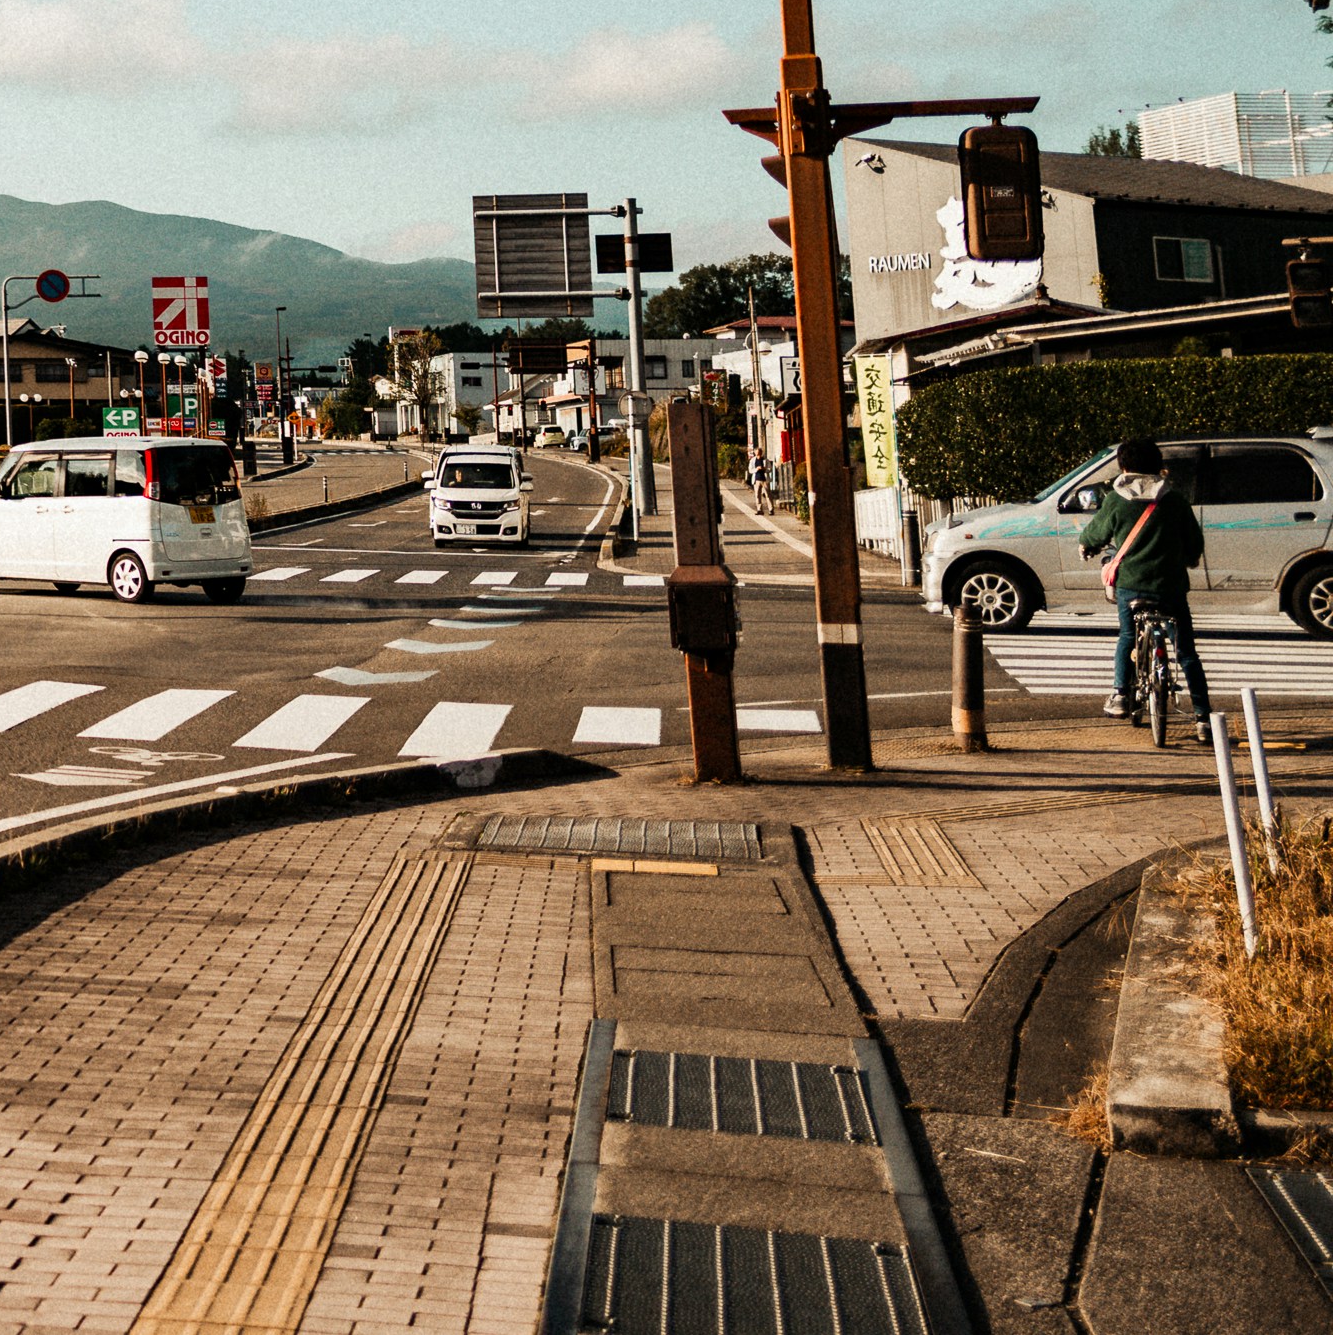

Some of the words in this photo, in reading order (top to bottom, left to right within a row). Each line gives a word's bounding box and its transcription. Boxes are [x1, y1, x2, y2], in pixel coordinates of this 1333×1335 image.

[868, 252, 931, 273] RAUMEN
[155, 331, 209, 344] OGINO
[184, 397, 198, 415] P
[121, 409, 137, 426] P
